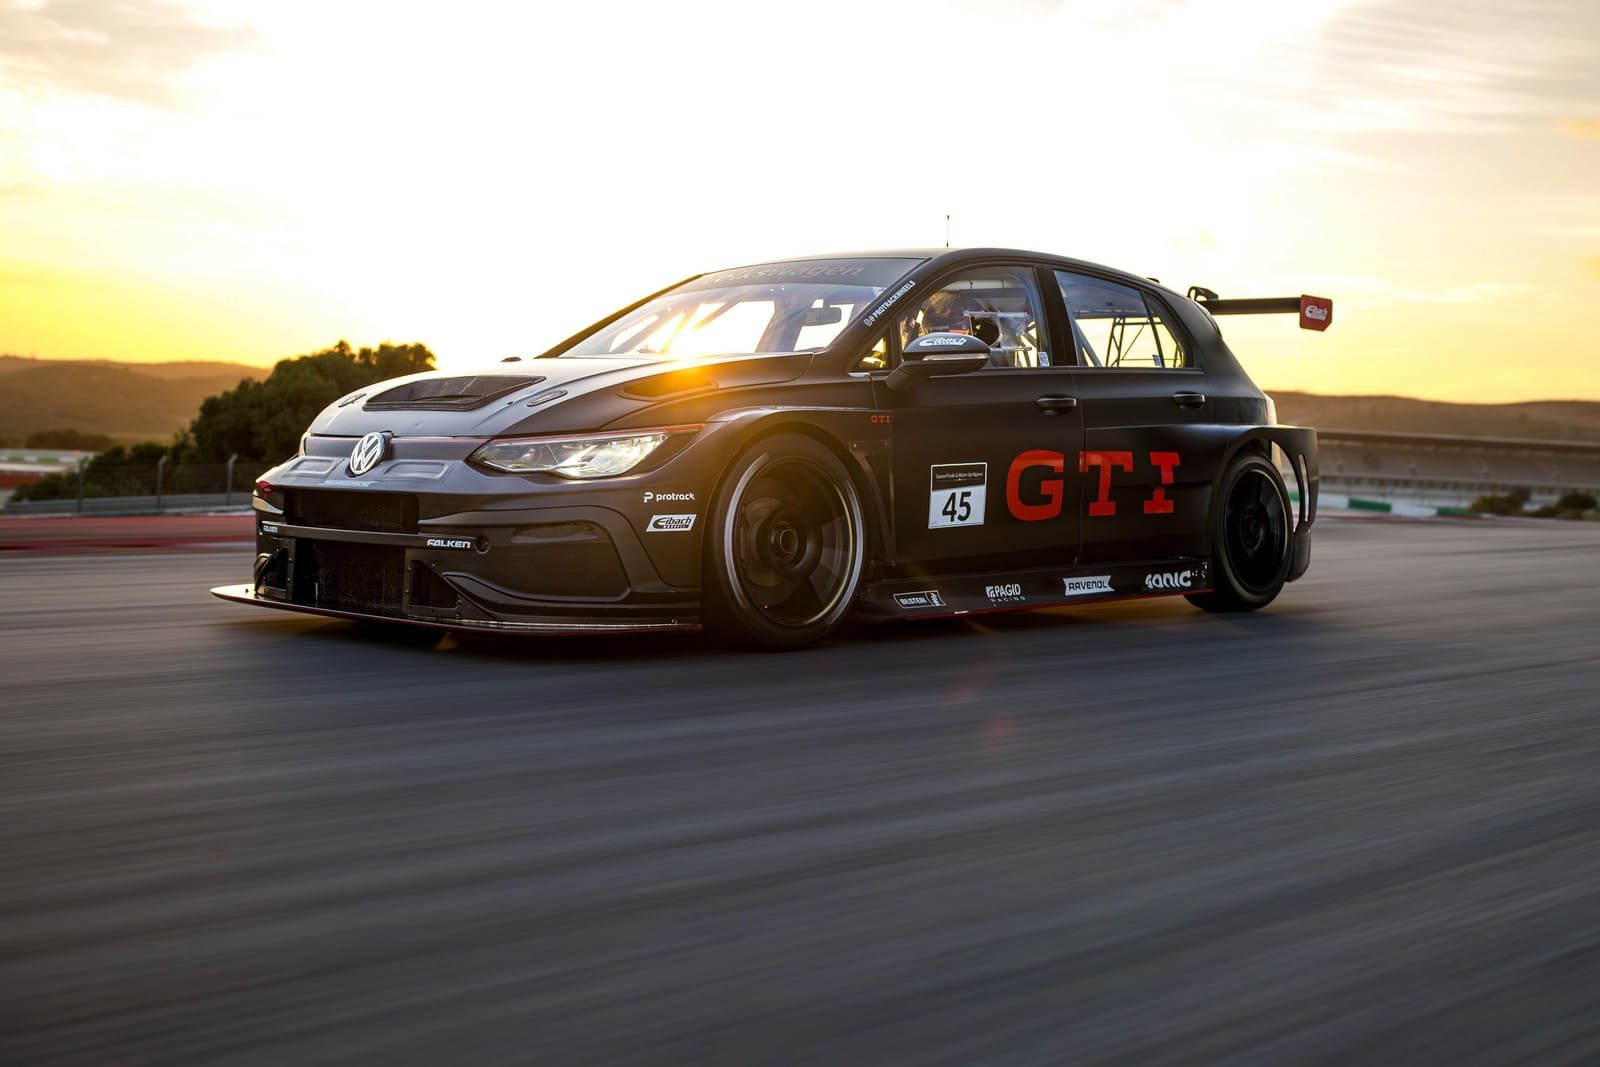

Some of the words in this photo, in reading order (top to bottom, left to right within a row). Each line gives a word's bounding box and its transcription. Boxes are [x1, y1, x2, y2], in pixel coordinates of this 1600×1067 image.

[870, 415, 890, 423] GTI
[1006, 450, 1180, 521] GTI
[656, 492, 695, 502] protrack
[942, 491, 972, 522] 45
[994, 583, 1022, 597] PAGID
[1068, 581, 1108, 591] RAVENOL
